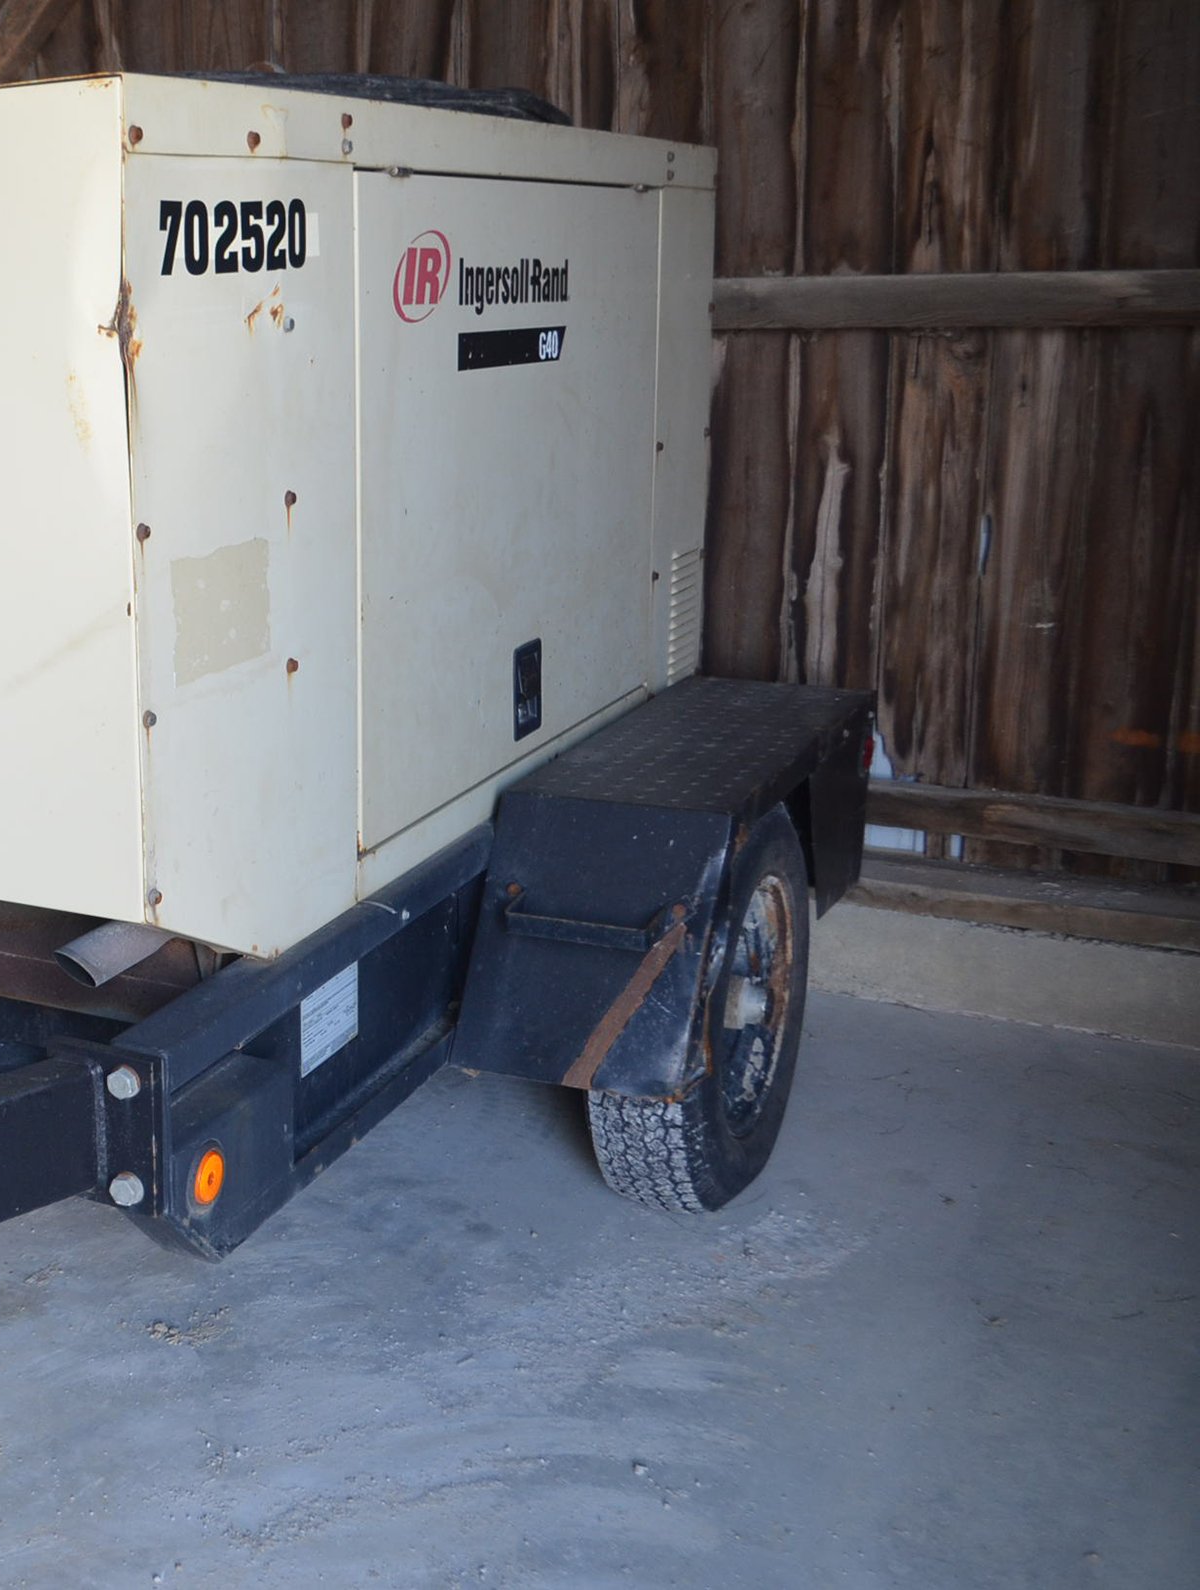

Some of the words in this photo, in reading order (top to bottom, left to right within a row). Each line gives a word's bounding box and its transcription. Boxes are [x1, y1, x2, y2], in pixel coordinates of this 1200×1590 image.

[159, 198, 306, 276] 702520
[402, 247, 442, 306] IR
[459, 257, 568, 315] Ingersoll-Rand
[538, 330, 558, 360] G40
